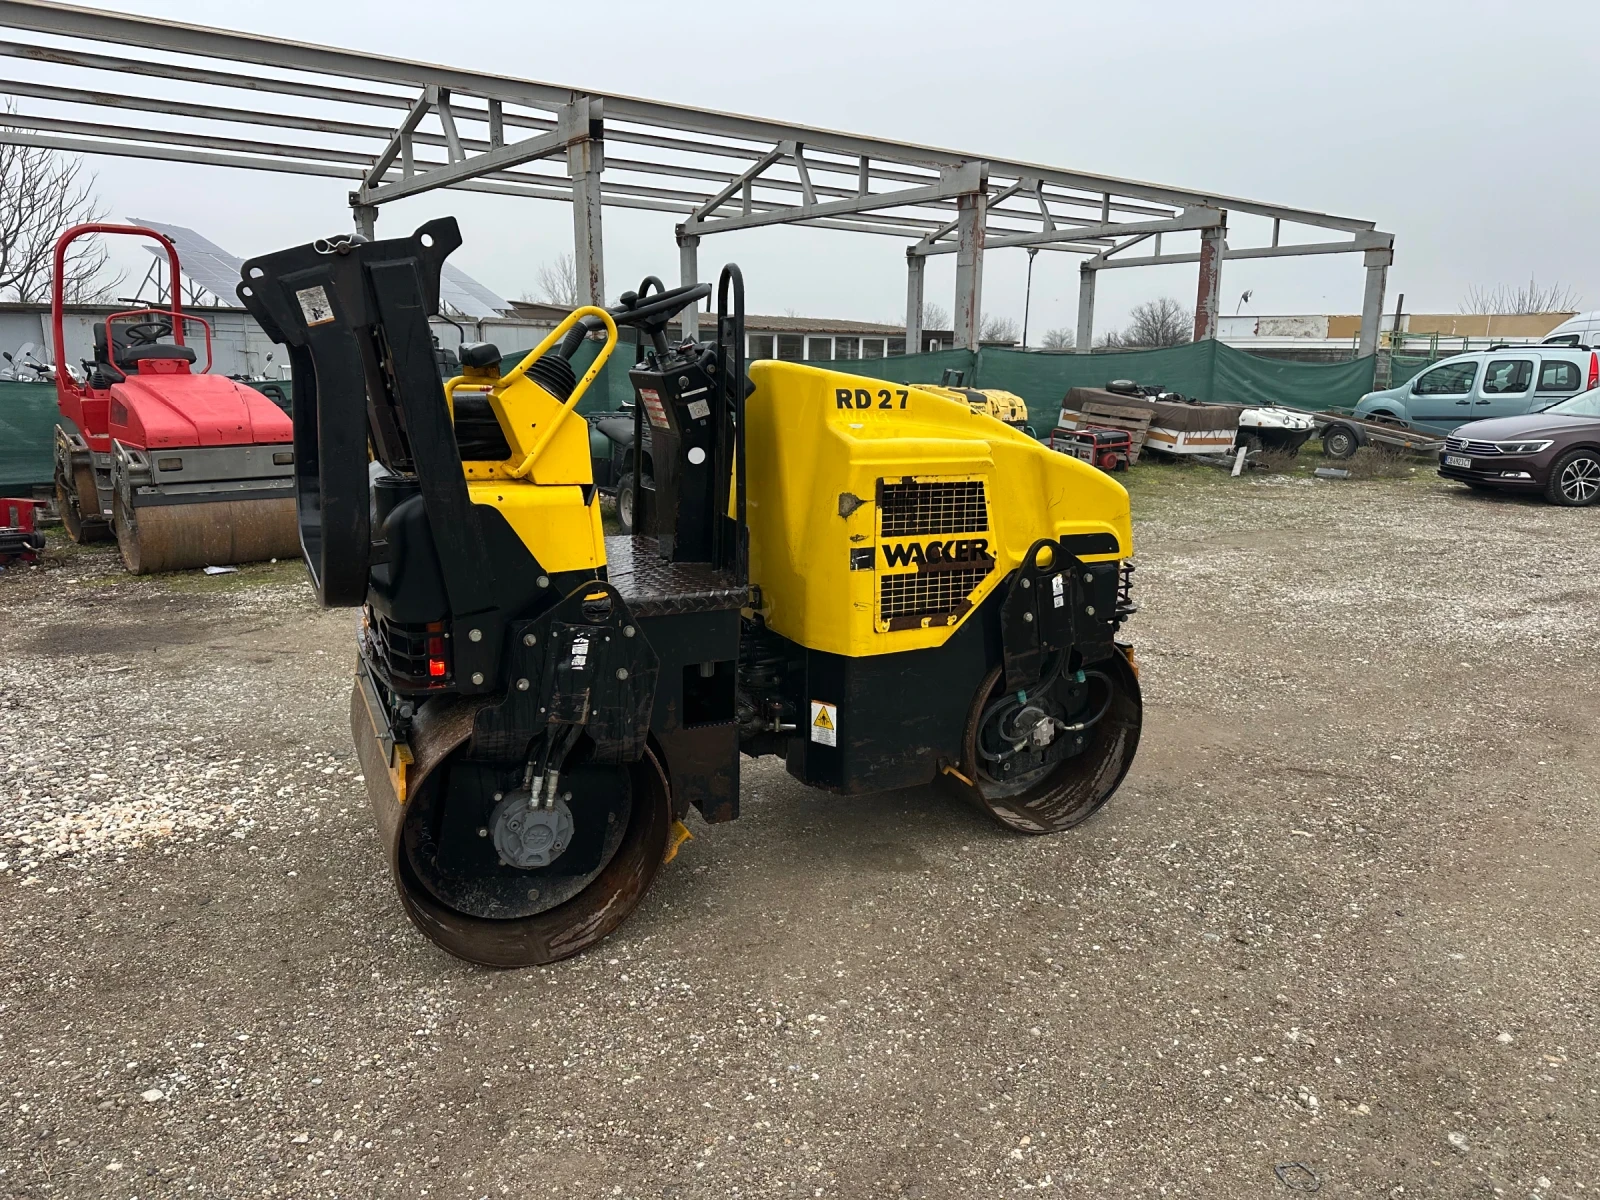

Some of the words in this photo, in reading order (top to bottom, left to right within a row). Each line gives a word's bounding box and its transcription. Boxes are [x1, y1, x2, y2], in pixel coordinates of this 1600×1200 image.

[835, 388, 872, 409] RD
[877, 389, 909, 410] 27
[881, 538, 989, 567] WACKER
